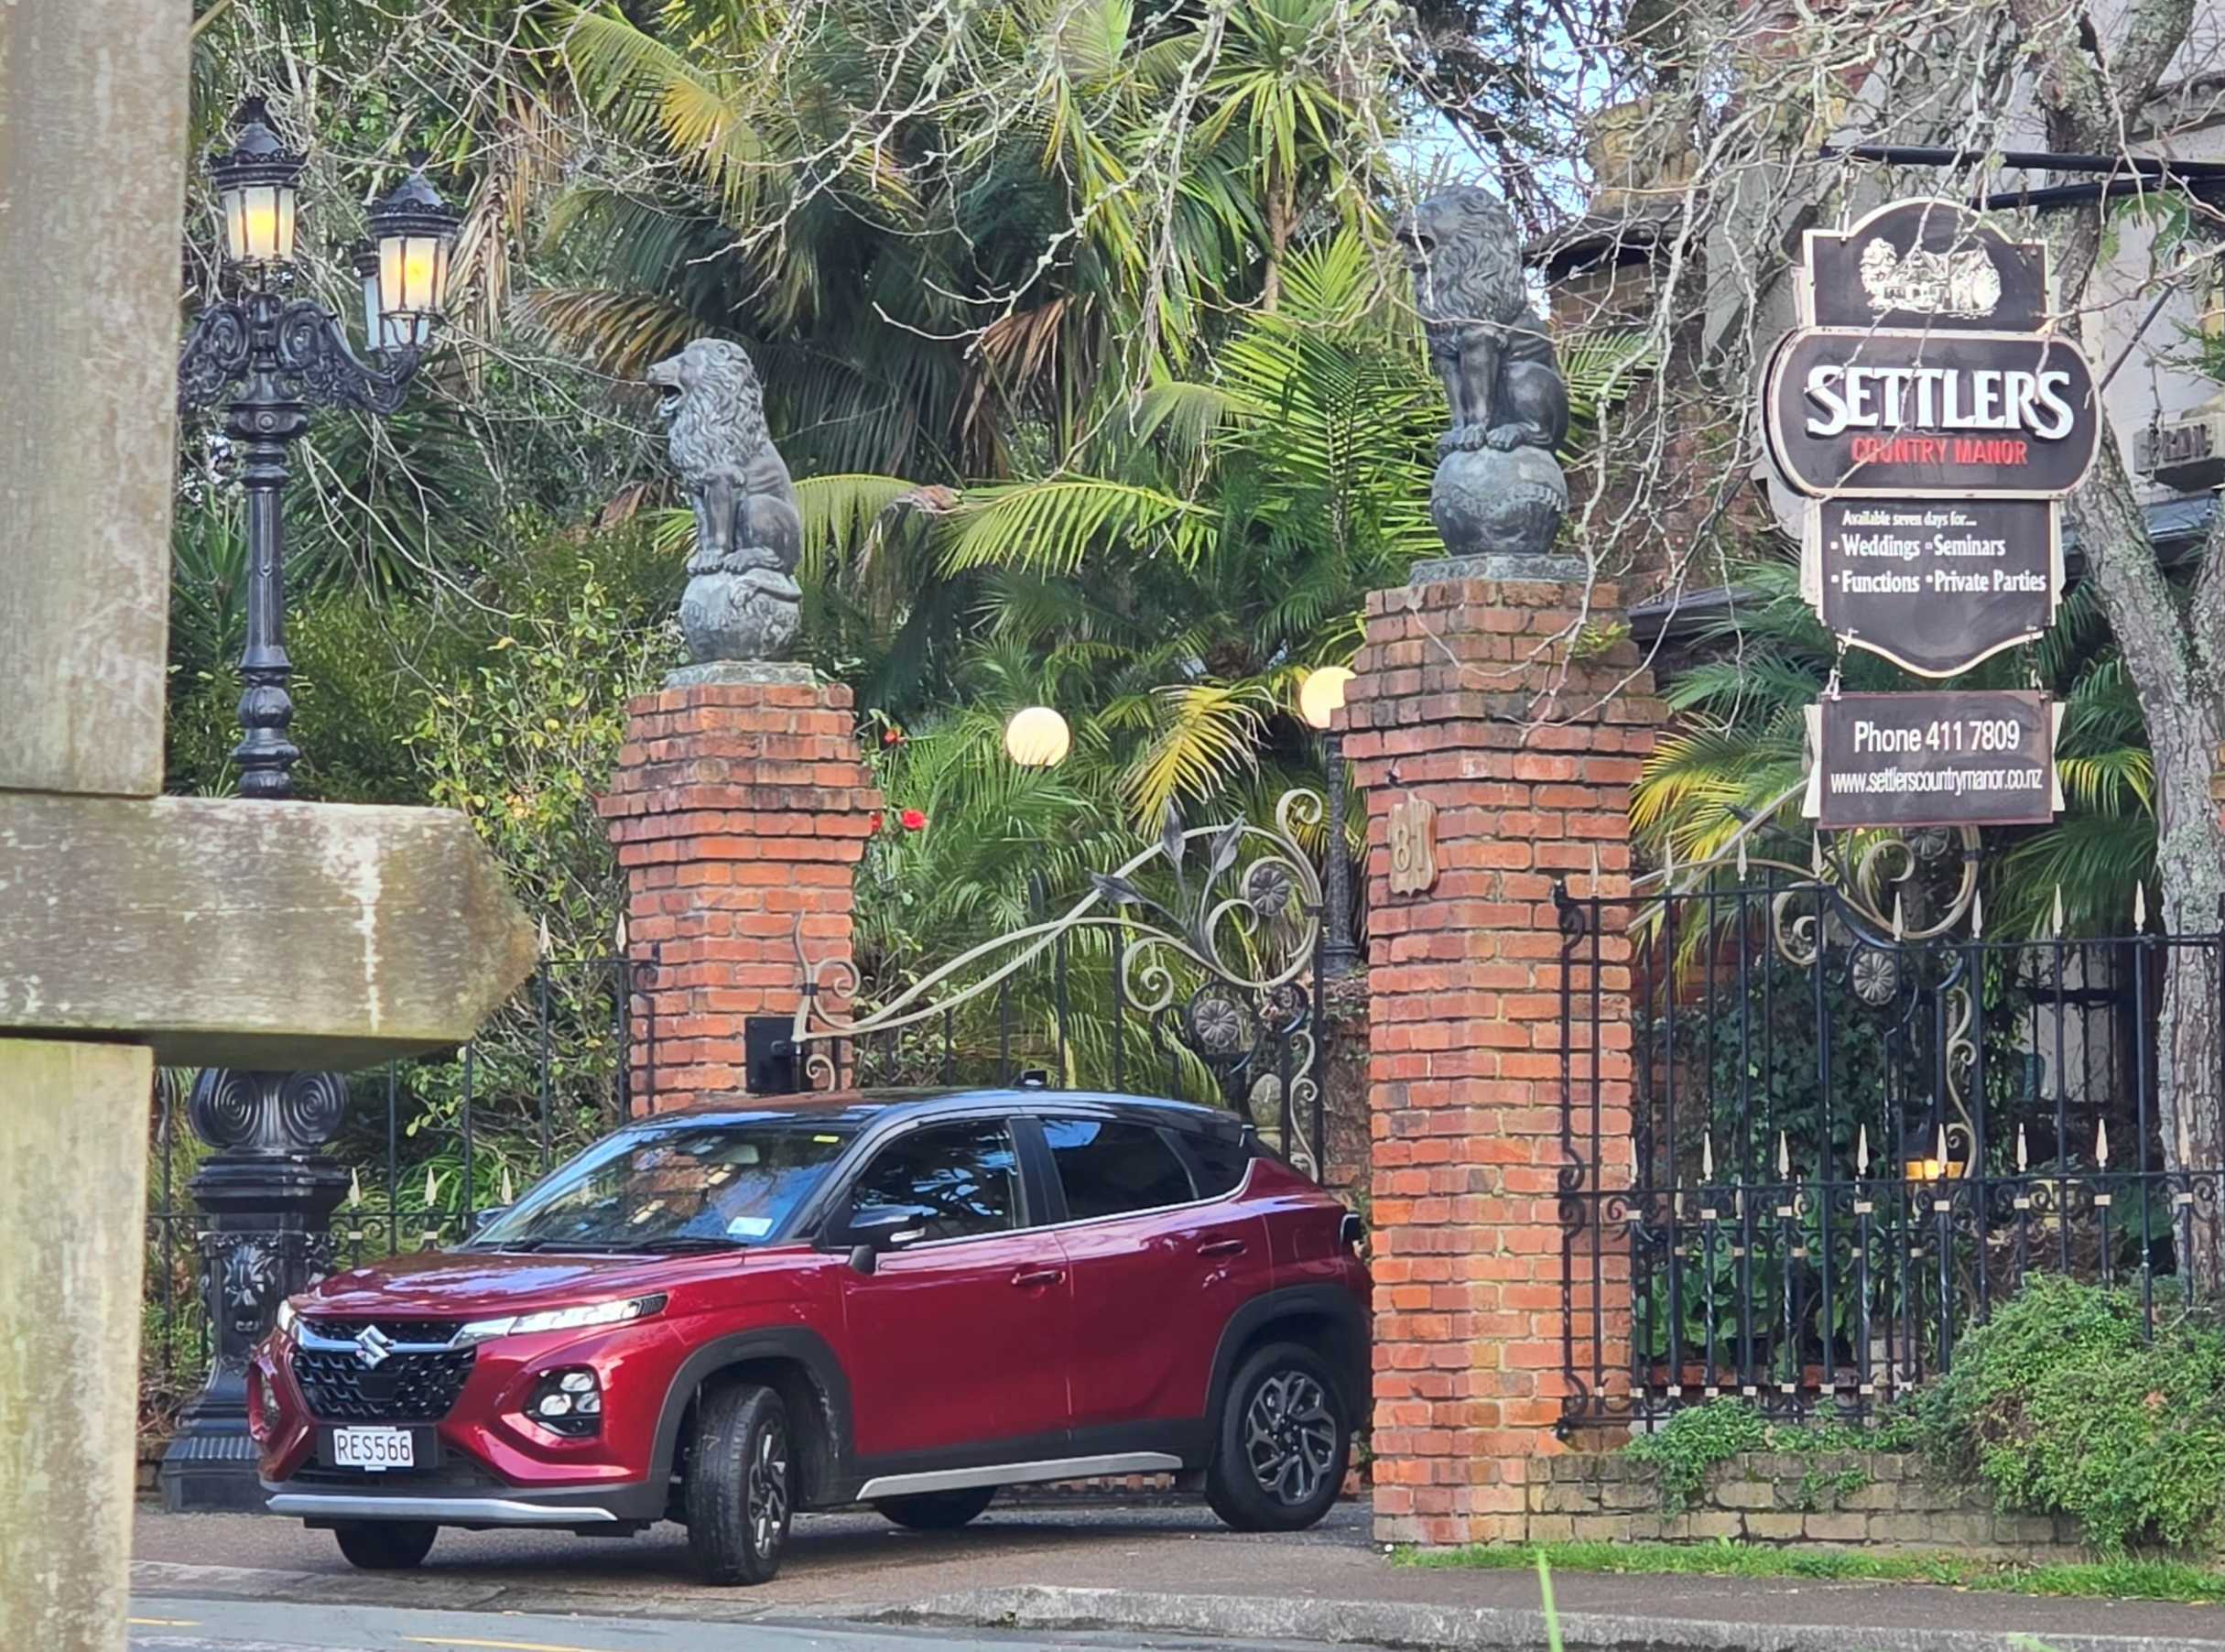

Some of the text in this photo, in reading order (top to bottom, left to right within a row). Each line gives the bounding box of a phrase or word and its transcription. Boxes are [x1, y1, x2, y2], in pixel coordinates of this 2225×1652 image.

[1804, 364, 2075, 440] SETTLERS
[1851, 436, 2029, 466] COUNTRY MANOR
[1841, 508, 1891, 527] Available
[1892, 514, 1923, 527] seven
[1923, 510, 1949, 529] days
[1840, 533, 2007, 561] Weddings Seminars
[1841, 569, 2047, 593] Functions Private Parties
[1853, 719, 2020, 754] Phone 411 7809
[1830, 766, 2044, 796] www.settlerscountrymanor.co.nz
[336, 1434, 410, 1462] RES566
